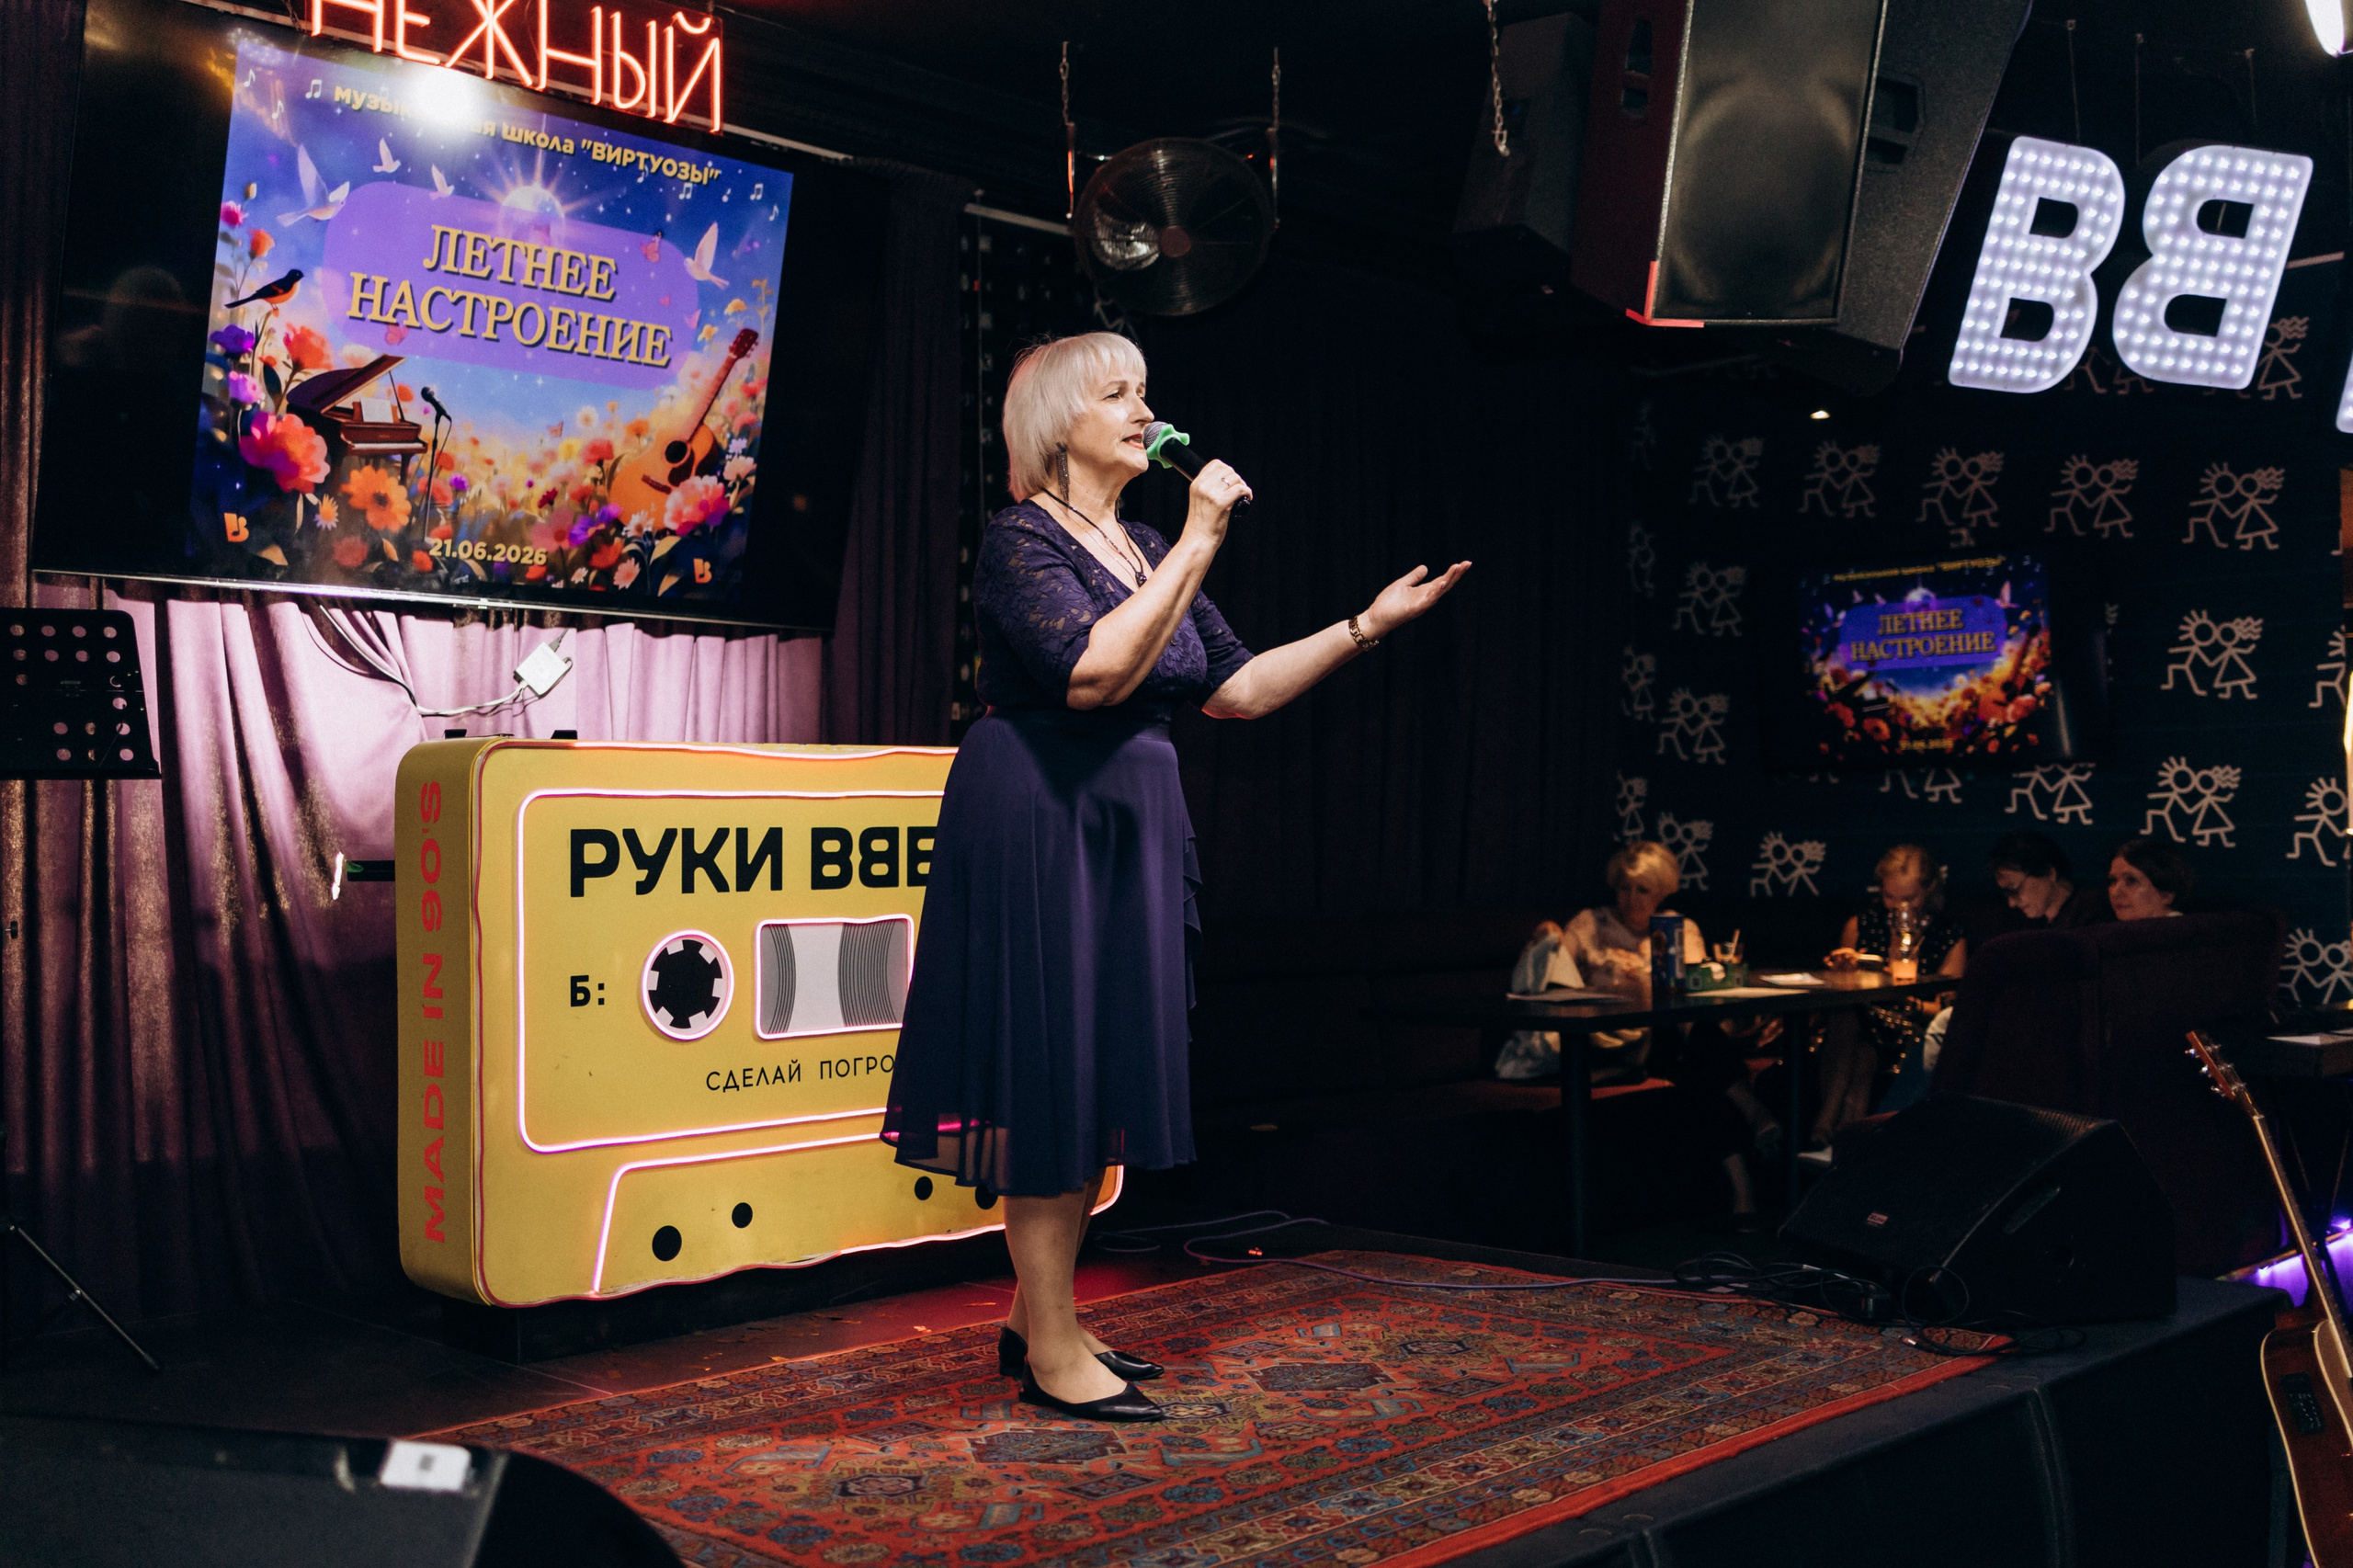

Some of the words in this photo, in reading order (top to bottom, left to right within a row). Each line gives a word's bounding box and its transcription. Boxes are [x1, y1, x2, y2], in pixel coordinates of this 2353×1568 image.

[334, 85, 496, 136] музыкая
[502, 123, 574, 154] школа
[581, 139, 722, 185] "ВИРТУОЗЫ"
[423, 224, 617, 301] ЛЕТНЕЕ
[346, 272, 673, 367] НАСТРОЕНИЕ
[429, 538, 548, 565] 21.06.2026
[1851, 631, 1997, 661] НАСТРОЕНИЕ
[1878, 608, 1964, 635] ЛЕТНЕЕ
[420, 781, 442, 932] 90'S
[570, 826, 783, 898] РУКИ
[423, 953, 443, 1019] IN
[570, 974, 605, 1007] Б:
[706, 1059, 801, 1093] СДЕЛАЙ
[423, 1040, 445, 1243] MADE
